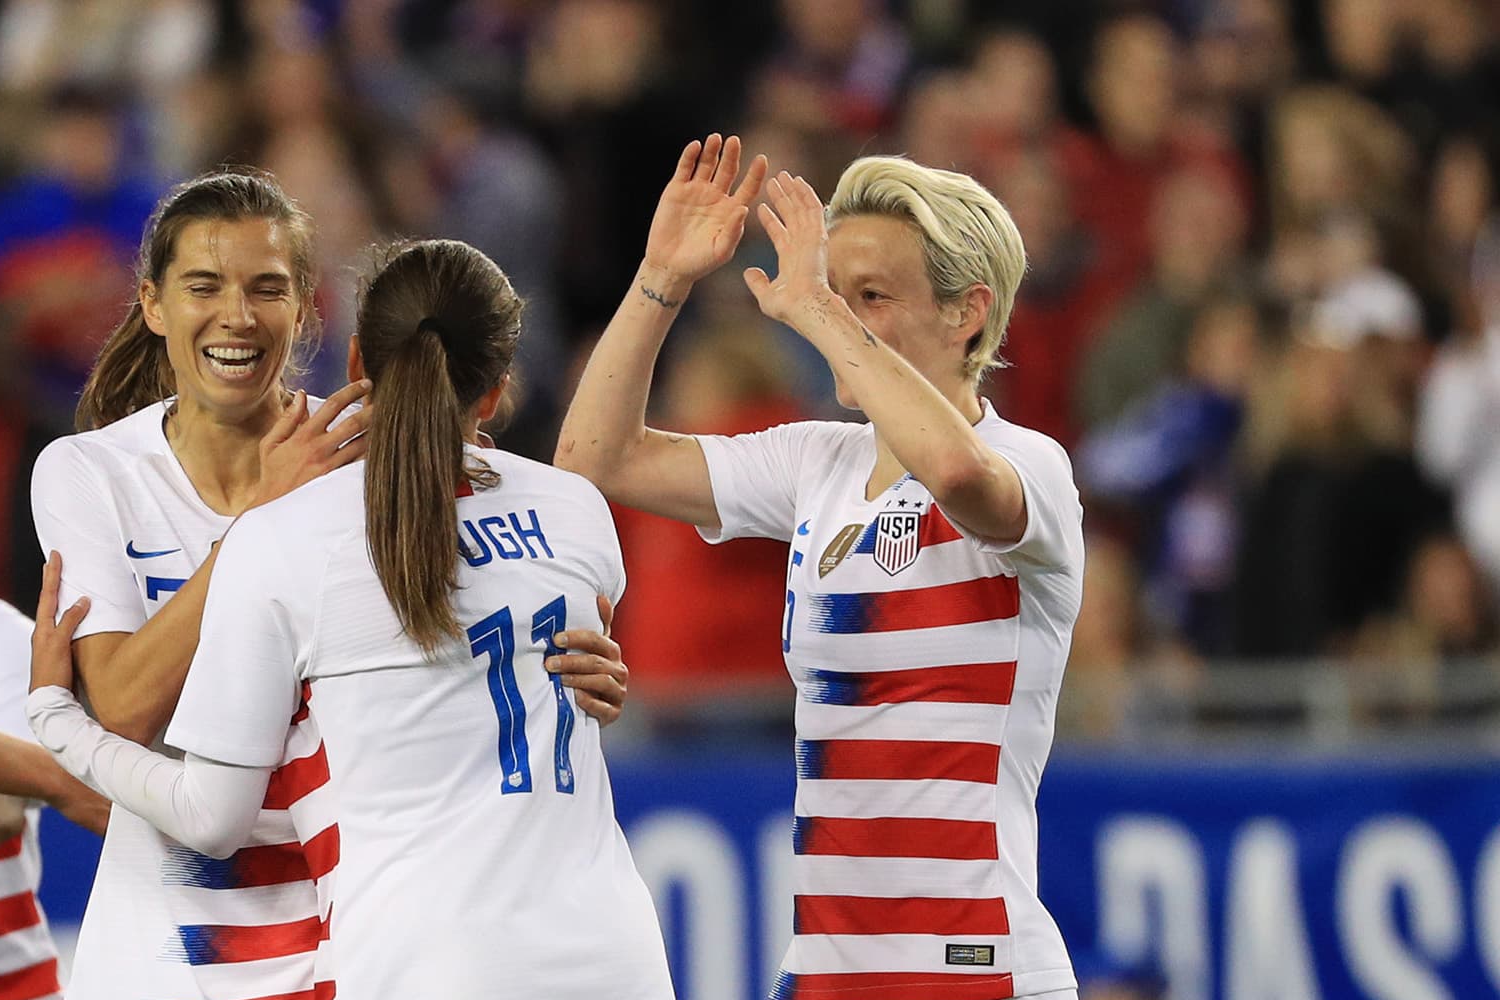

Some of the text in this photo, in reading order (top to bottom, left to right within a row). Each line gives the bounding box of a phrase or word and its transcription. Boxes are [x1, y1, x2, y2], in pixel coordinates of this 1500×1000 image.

[457, 510, 556, 568] UGH
[880, 516, 916, 540] USA
[467, 594, 576, 795] 11
